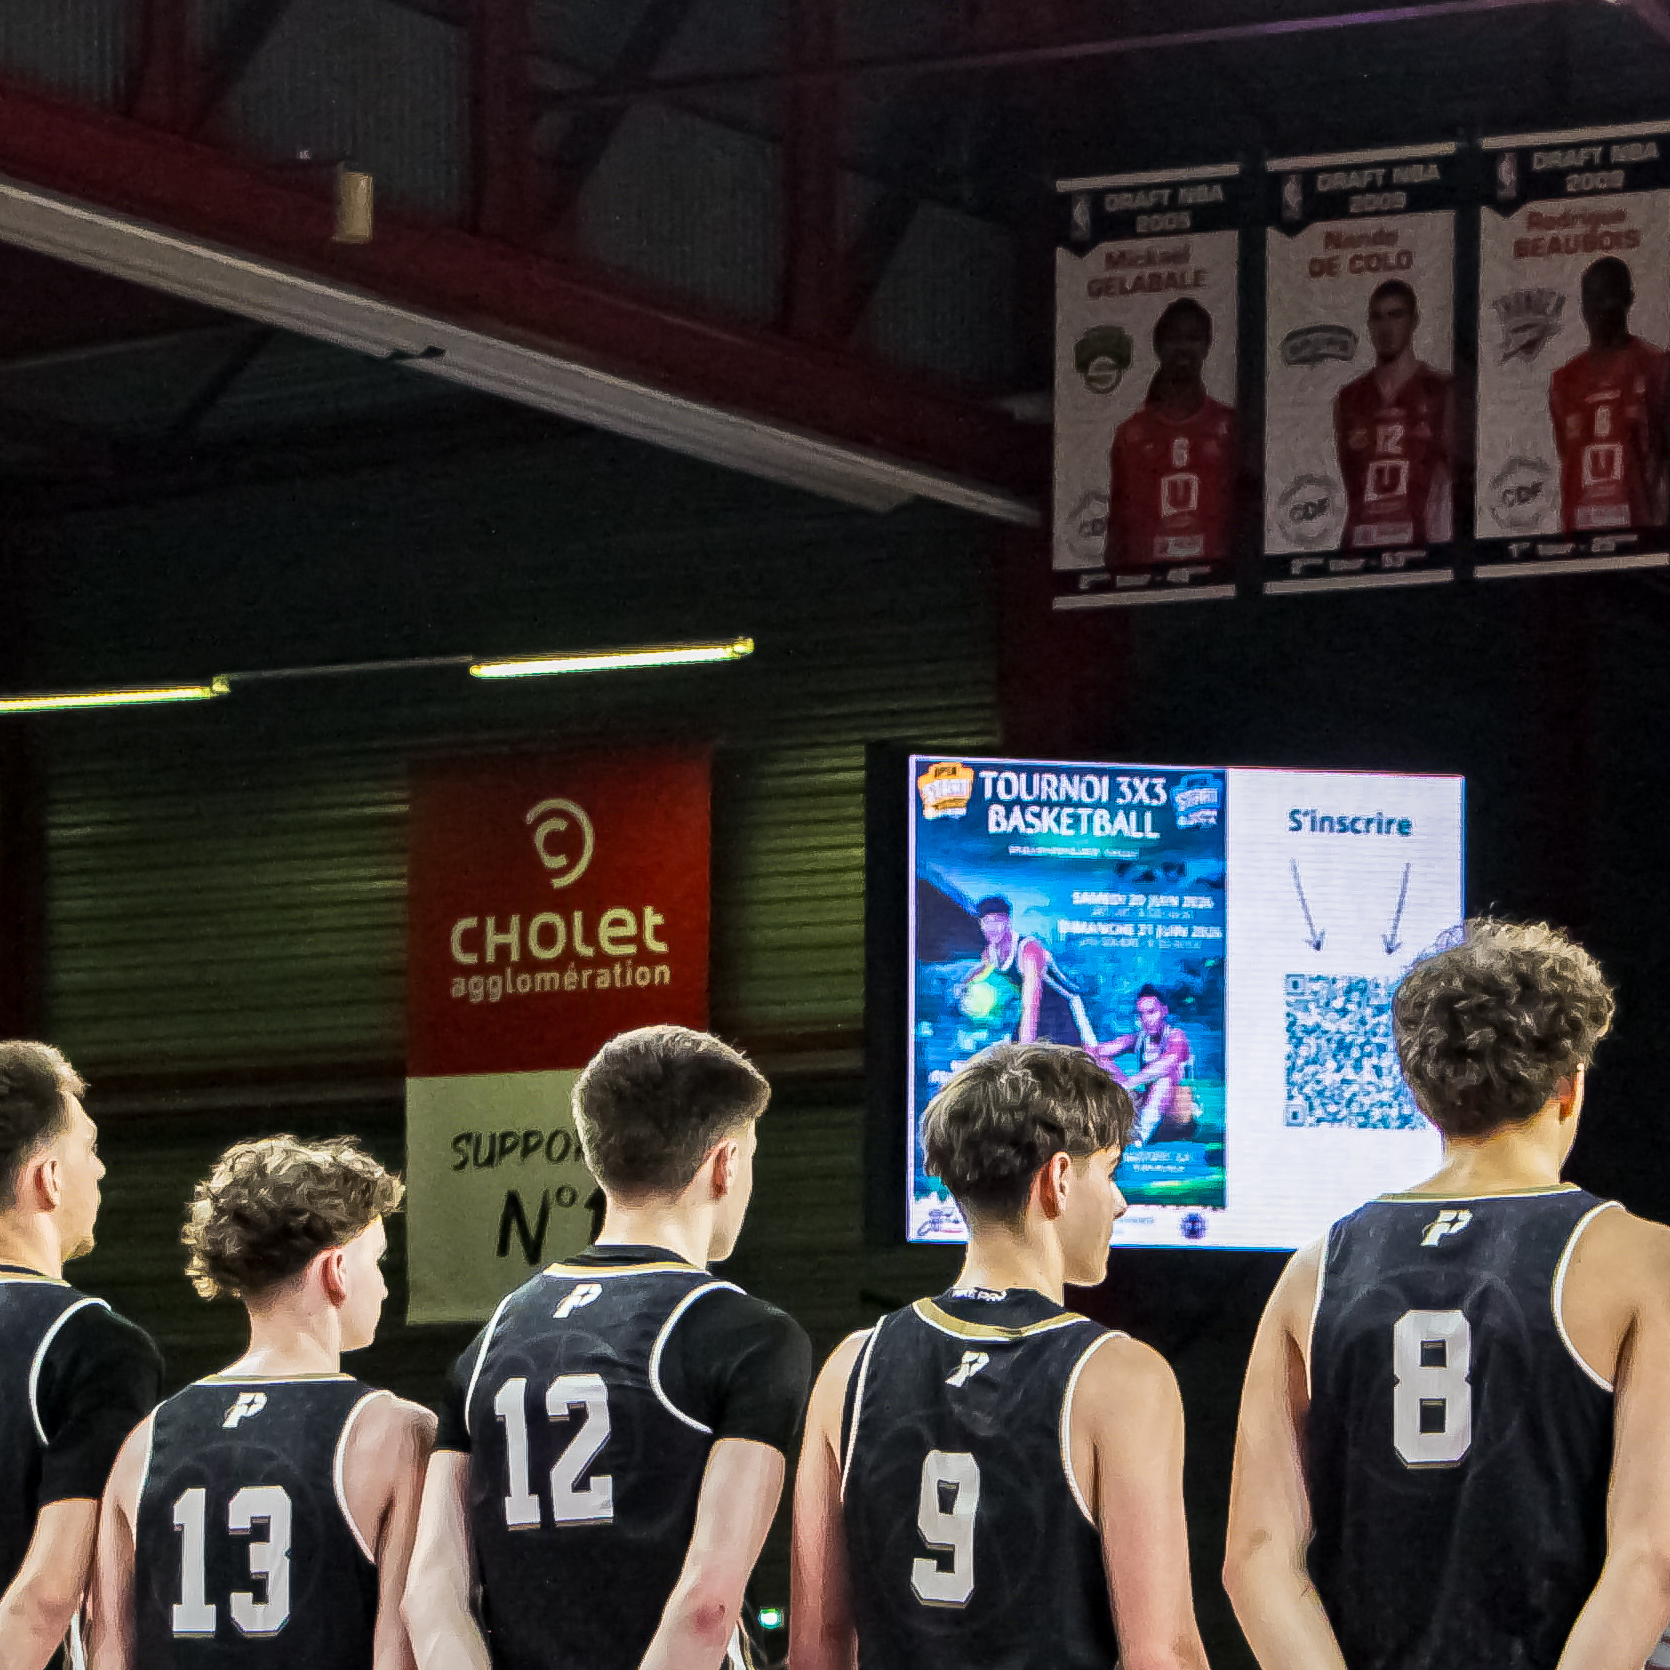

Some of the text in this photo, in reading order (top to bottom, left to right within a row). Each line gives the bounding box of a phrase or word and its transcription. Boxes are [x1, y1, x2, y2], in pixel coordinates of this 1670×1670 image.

[1533, 147, 1602, 172] DRAFT
[1514, 229, 1639, 259] BEAUBOIS
[1309, 249, 1415, 278] DE COLO
[979, 771, 1109, 802] TOURNOI
[1116, 777, 1167, 805] 3X3
[987, 804, 1160, 838] BASKETBALL
[1288, 809, 1412, 837] S'inscrire
[449, 961, 670, 1003] agglomération
[449, 1128, 586, 1173] SUPPO
[1392, 1309, 1473, 1471] 8
[494, 1374, 615, 1531] 12
[911, 1450, 981, 1608] 9
[172, 1486, 292, 1638] 13
